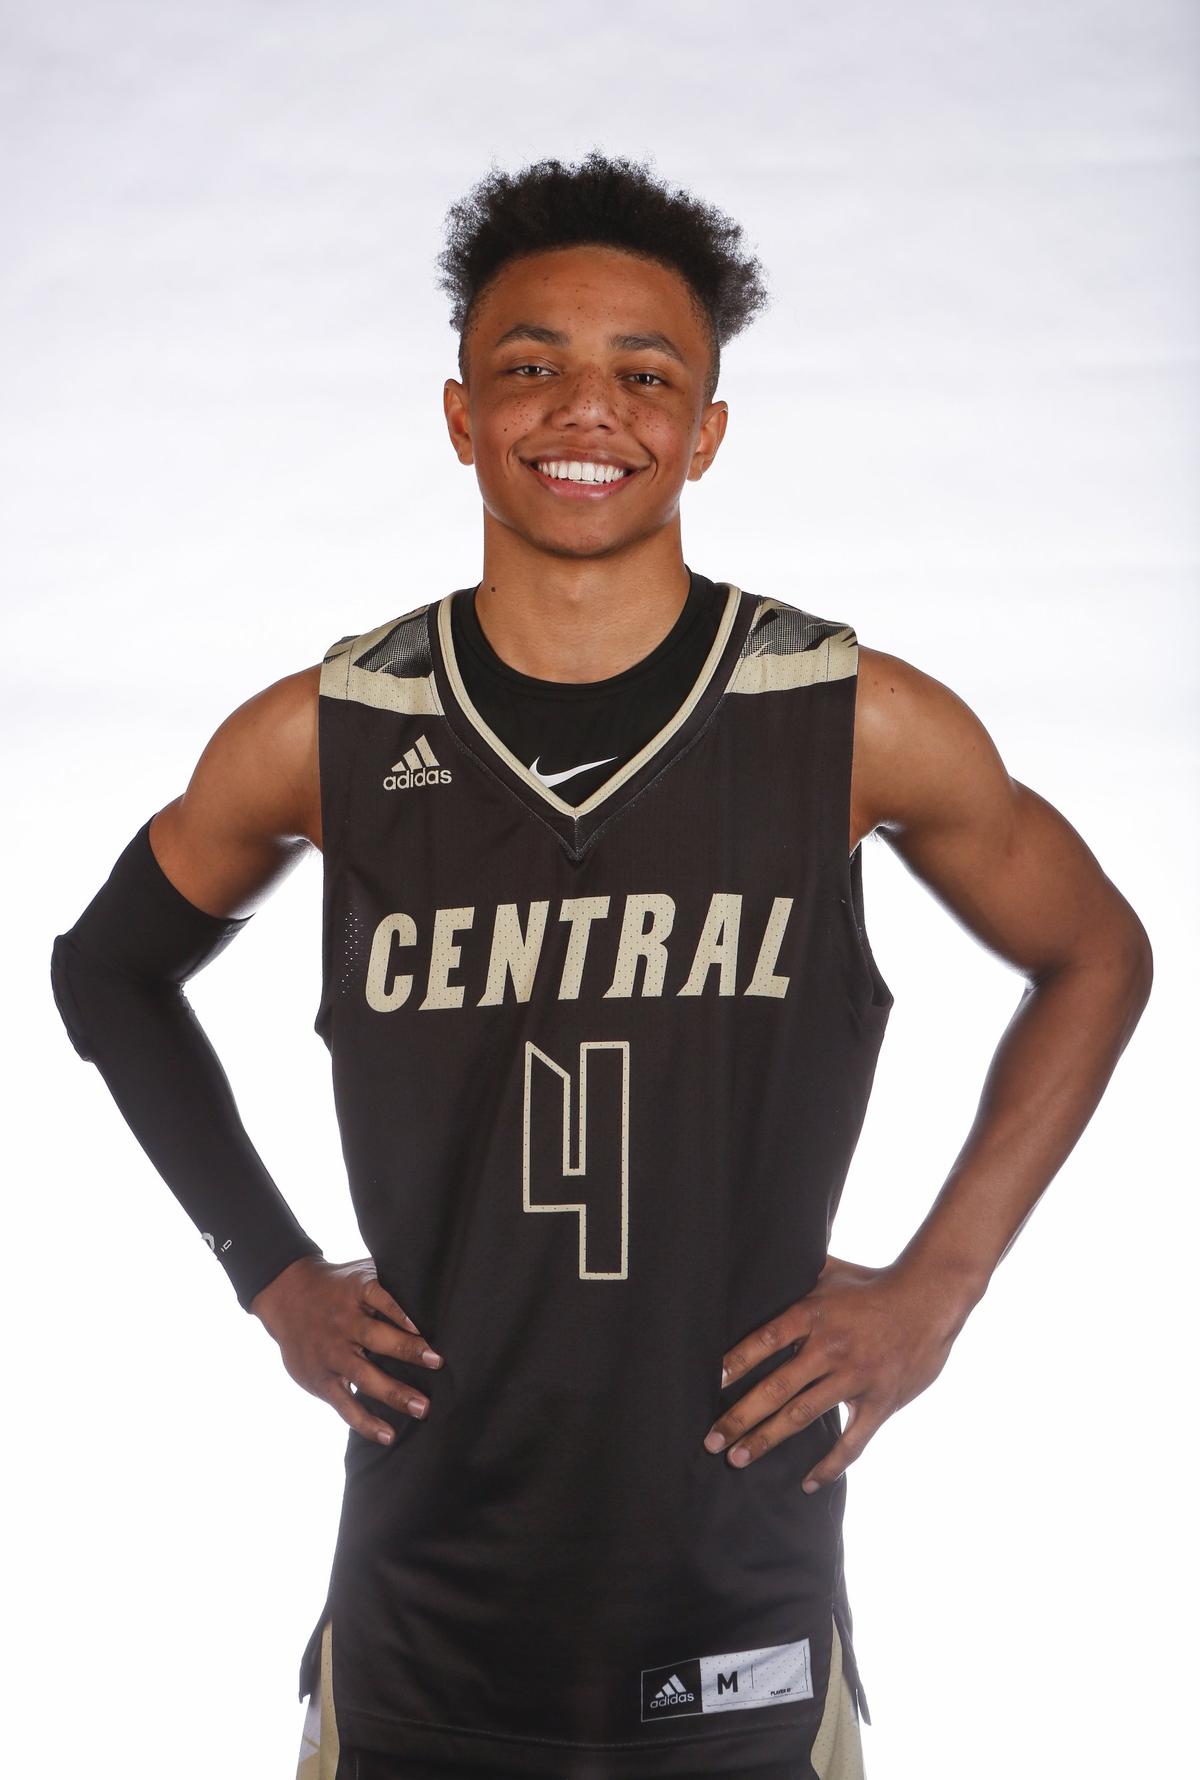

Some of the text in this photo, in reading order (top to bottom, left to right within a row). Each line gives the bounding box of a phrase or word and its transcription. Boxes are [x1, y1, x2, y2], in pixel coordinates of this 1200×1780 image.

[383, 767, 453, 790] adidas
[365, 893, 794, 1013] CENTRAL
[523, 1040, 630, 1280] 4
[716, 1670, 739, 1695] M
[649, 1691, 695, 1709] adidas
